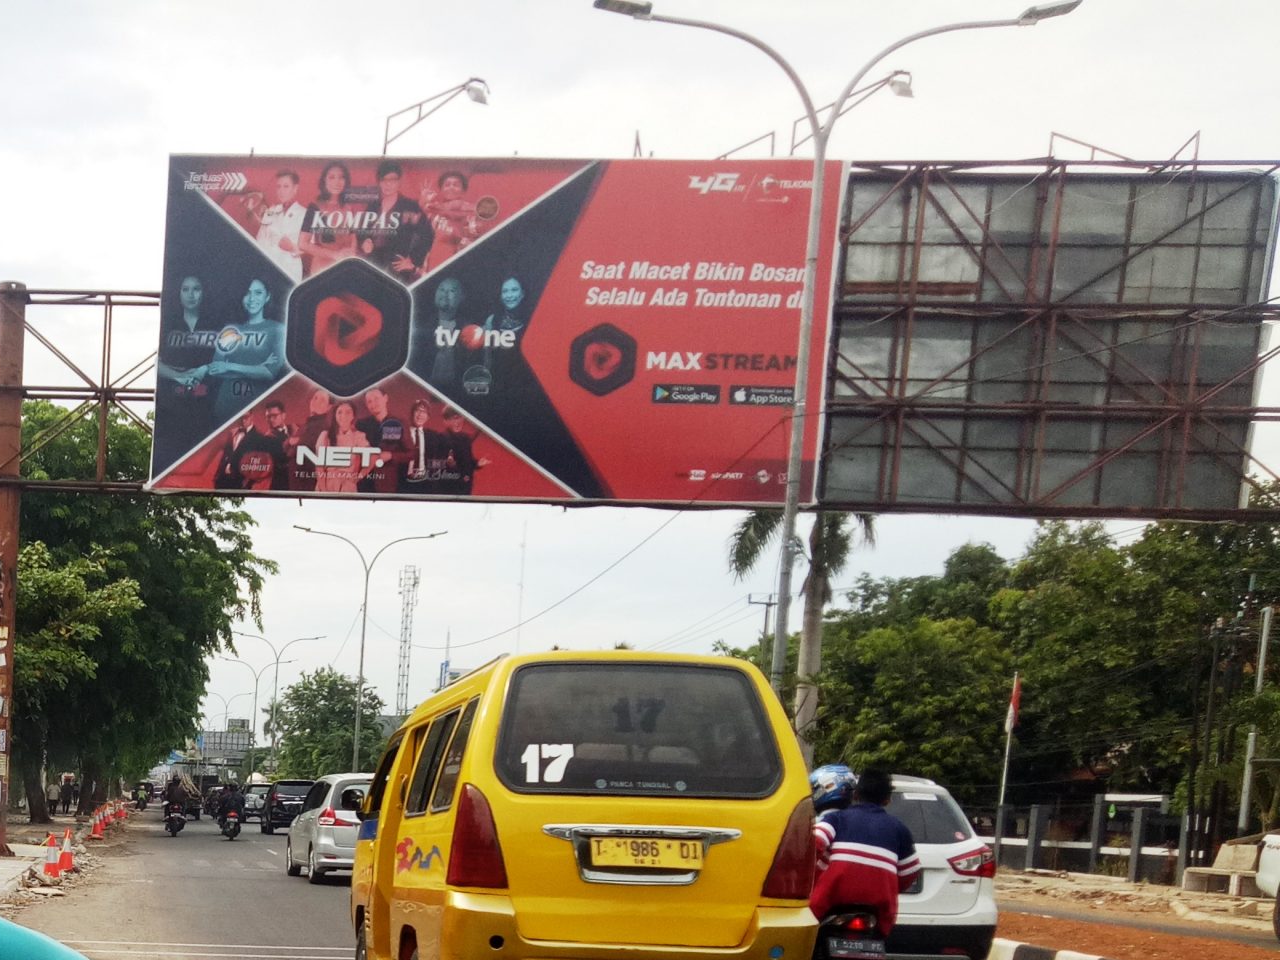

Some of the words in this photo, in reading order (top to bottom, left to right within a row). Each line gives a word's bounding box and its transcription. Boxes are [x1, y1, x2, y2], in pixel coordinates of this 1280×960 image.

[688, 172, 742, 194] 4G
[311, 210, 401, 229] KOMPAS
[581, 261, 626, 280] Saat
[629, 261, 691, 280] Macet
[694, 262, 745, 281] Bikin
[585, 287, 646, 306] Selalu
[649, 288, 688, 307] Ada
[694, 288, 782, 308] Tontonan
[243, 331, 268, 347] TV
[672, 391, 700, 402] Google
[701, 392, 717, 402] Play
[750, 394, 766, 403] App
[769, 394, 793, 403] Store
[296, 445, 385, 468] NET.
[521, 743, 575, 783] 17
